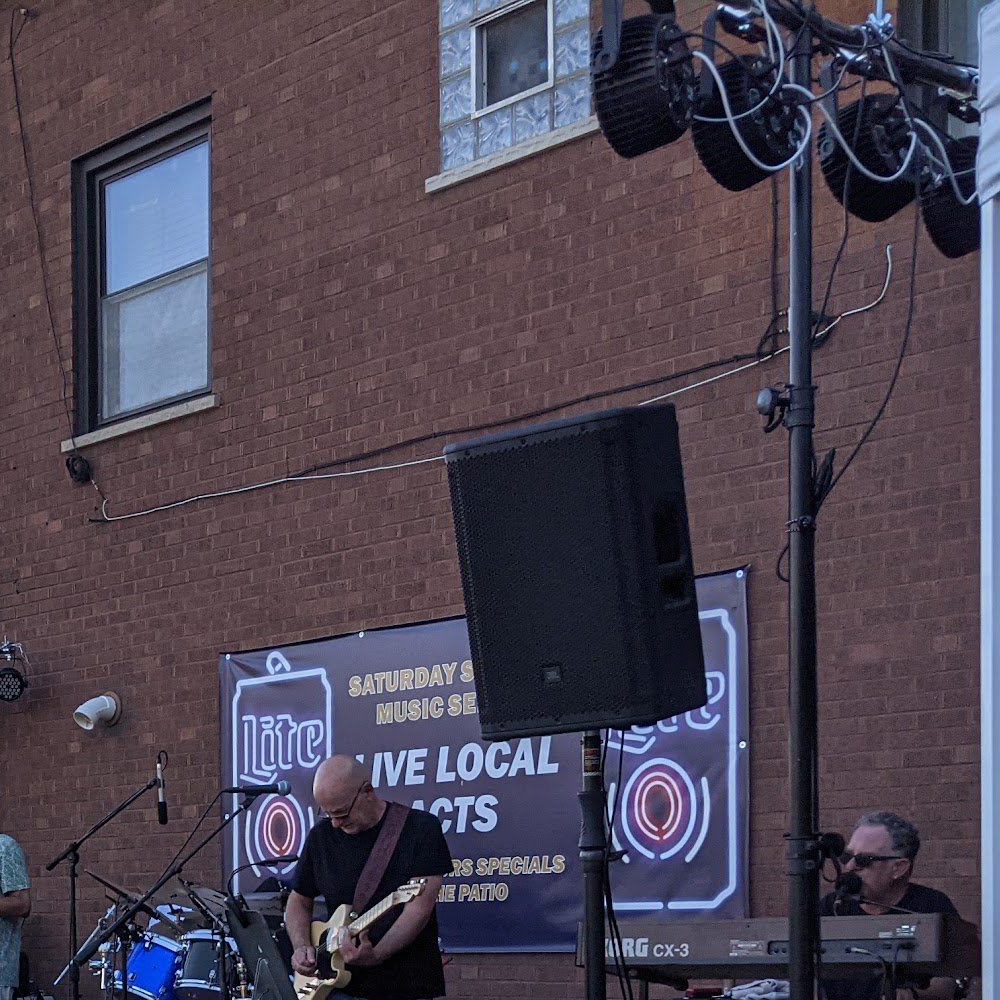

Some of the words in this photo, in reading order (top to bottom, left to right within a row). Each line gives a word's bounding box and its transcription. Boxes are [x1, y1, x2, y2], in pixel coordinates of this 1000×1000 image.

[348, 662, 458, 697] SATURDAY
[376, 696, 444, 725] MUSIC
[240, 714, 324, 785] Lite
[356, 746, 428, 788] IVE
[436, 736, 560, 781] LOCAL
[475, 854, 566, 876] SPECIALS
[458, 882, 509, 902] PATIO
[605, 938, 649, 957] ORG
[653, 943, 689, 957] CX-3
